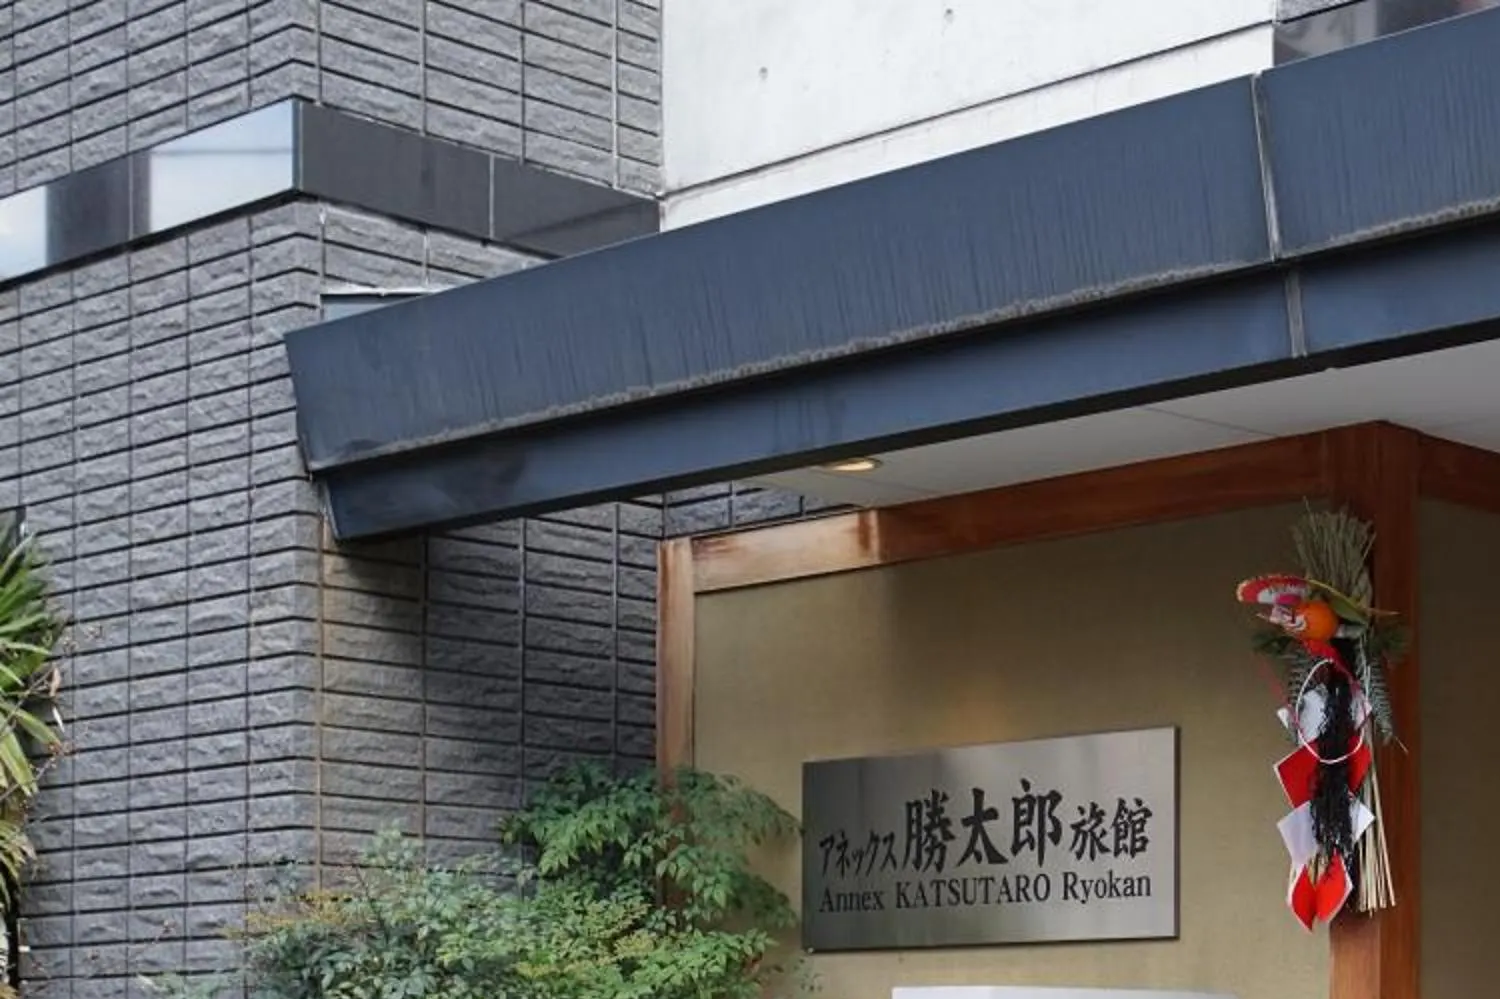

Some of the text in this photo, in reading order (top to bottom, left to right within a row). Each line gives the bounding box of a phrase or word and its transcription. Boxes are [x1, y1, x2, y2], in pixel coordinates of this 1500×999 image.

[818, 871, 1151, 913] Annex KATSUTARO Ryokan
